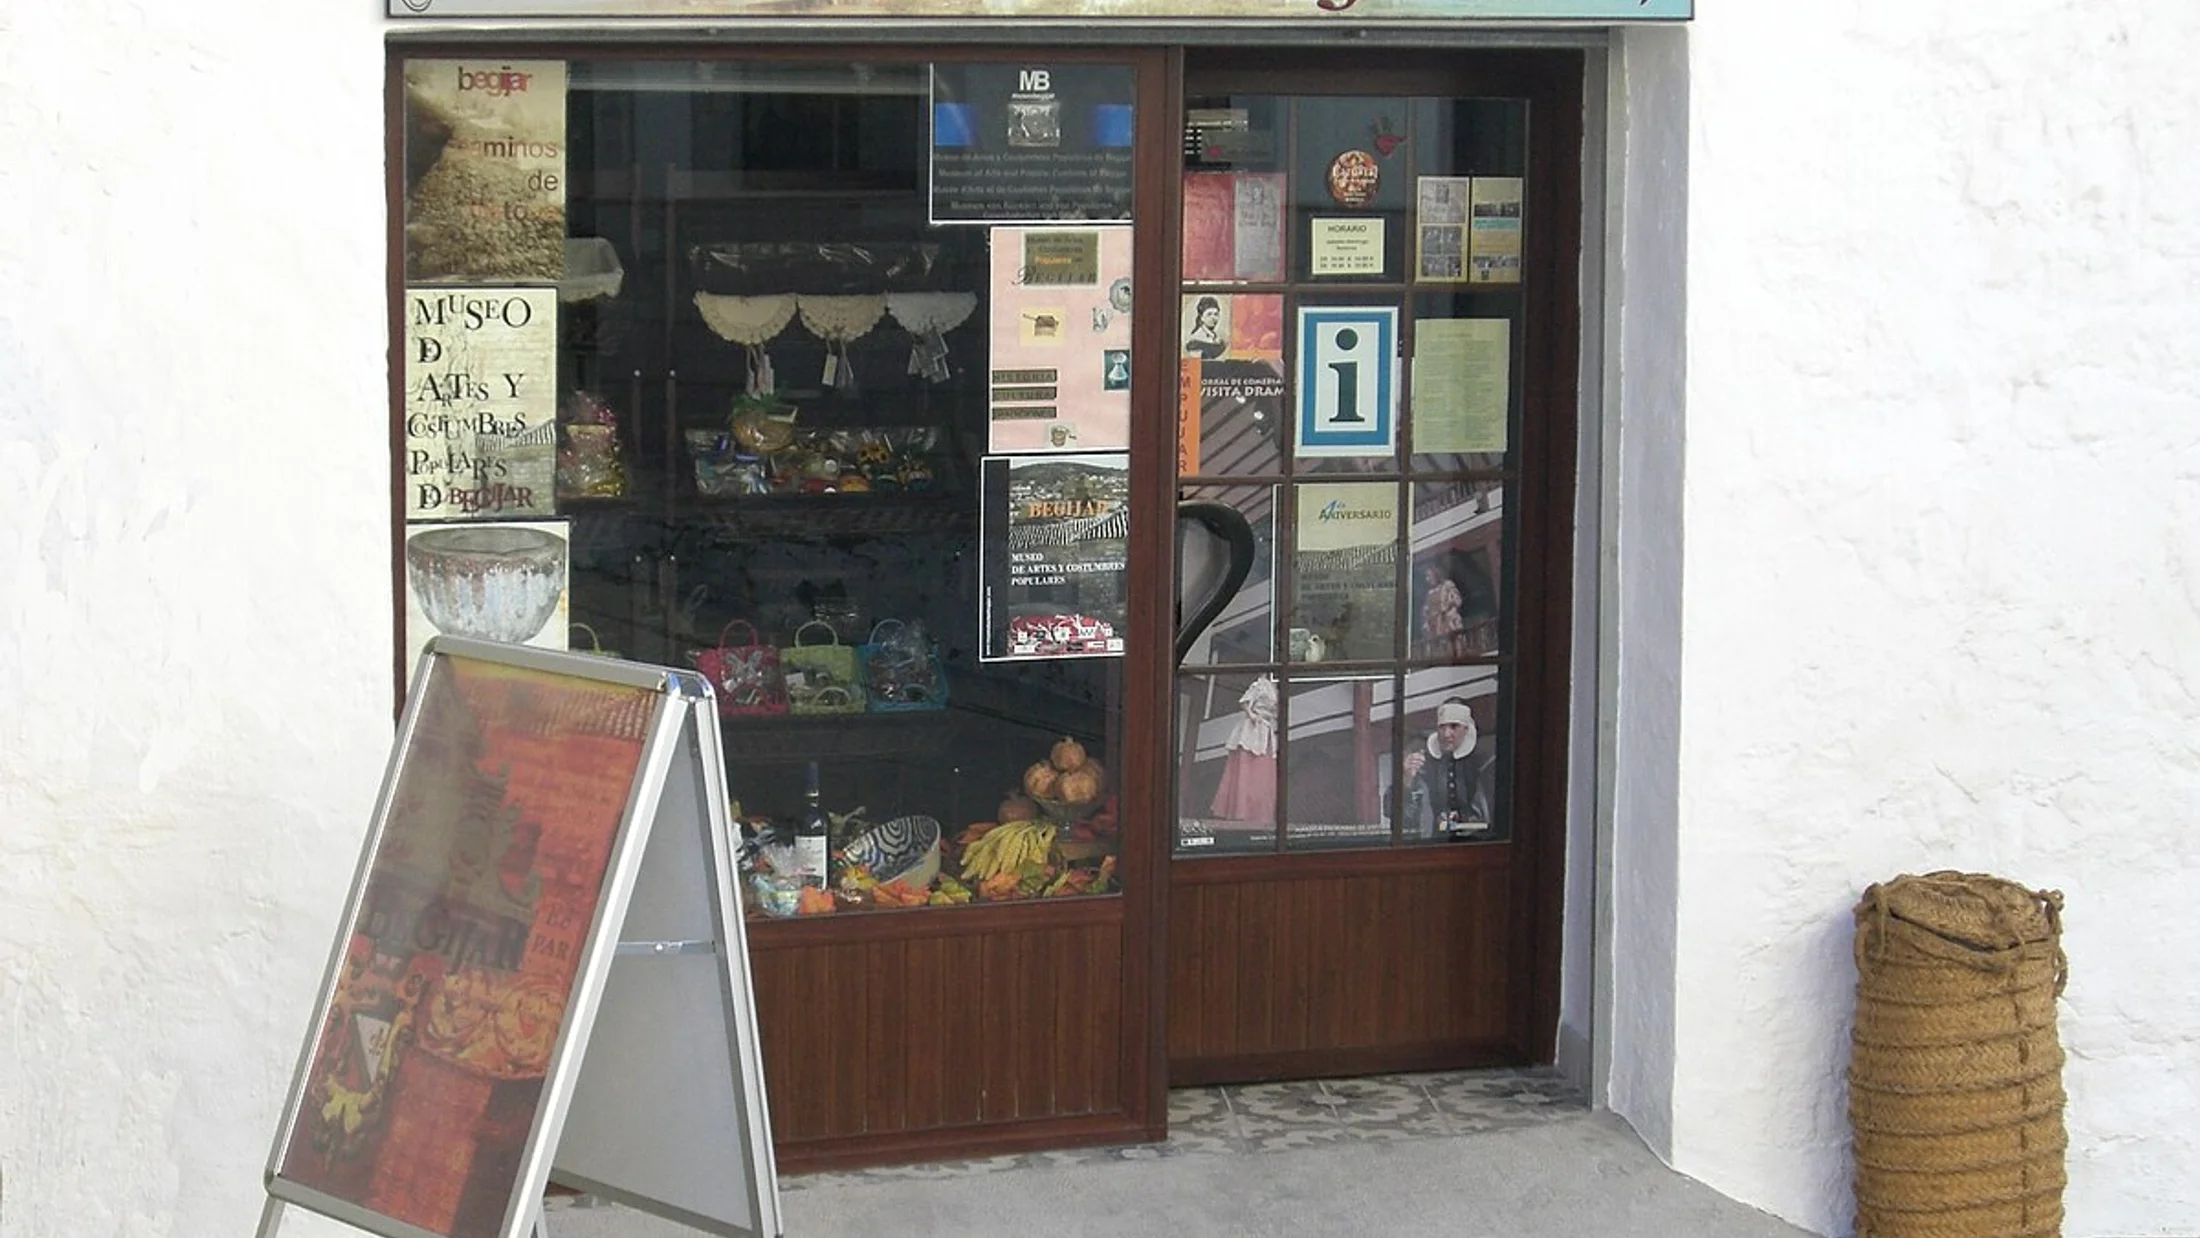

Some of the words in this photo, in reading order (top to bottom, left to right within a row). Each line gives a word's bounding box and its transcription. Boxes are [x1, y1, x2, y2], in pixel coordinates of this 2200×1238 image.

[1019, 70, 1050, 91] MB
[528, 169, 558, 191] de
[415, 295, 532, 331] MUSEO
[416, 373, 489, 407] ARTES
[503, 373, 526, 398] Y
[1243, 378, 1281, 386] COMEDIA
[1244, 385, 1284, 396] DRAM
[408, 411, 526, 440] COSTUMBRES
[1012, 553, 1044, 562] MUSEO
[1012, 565, 1026, 574] DE
[1028, 564, 1057, 573] ARTES
[1059, 564, 1064, 573] Y
[1012, 575, 1066, 586] POPULARES
